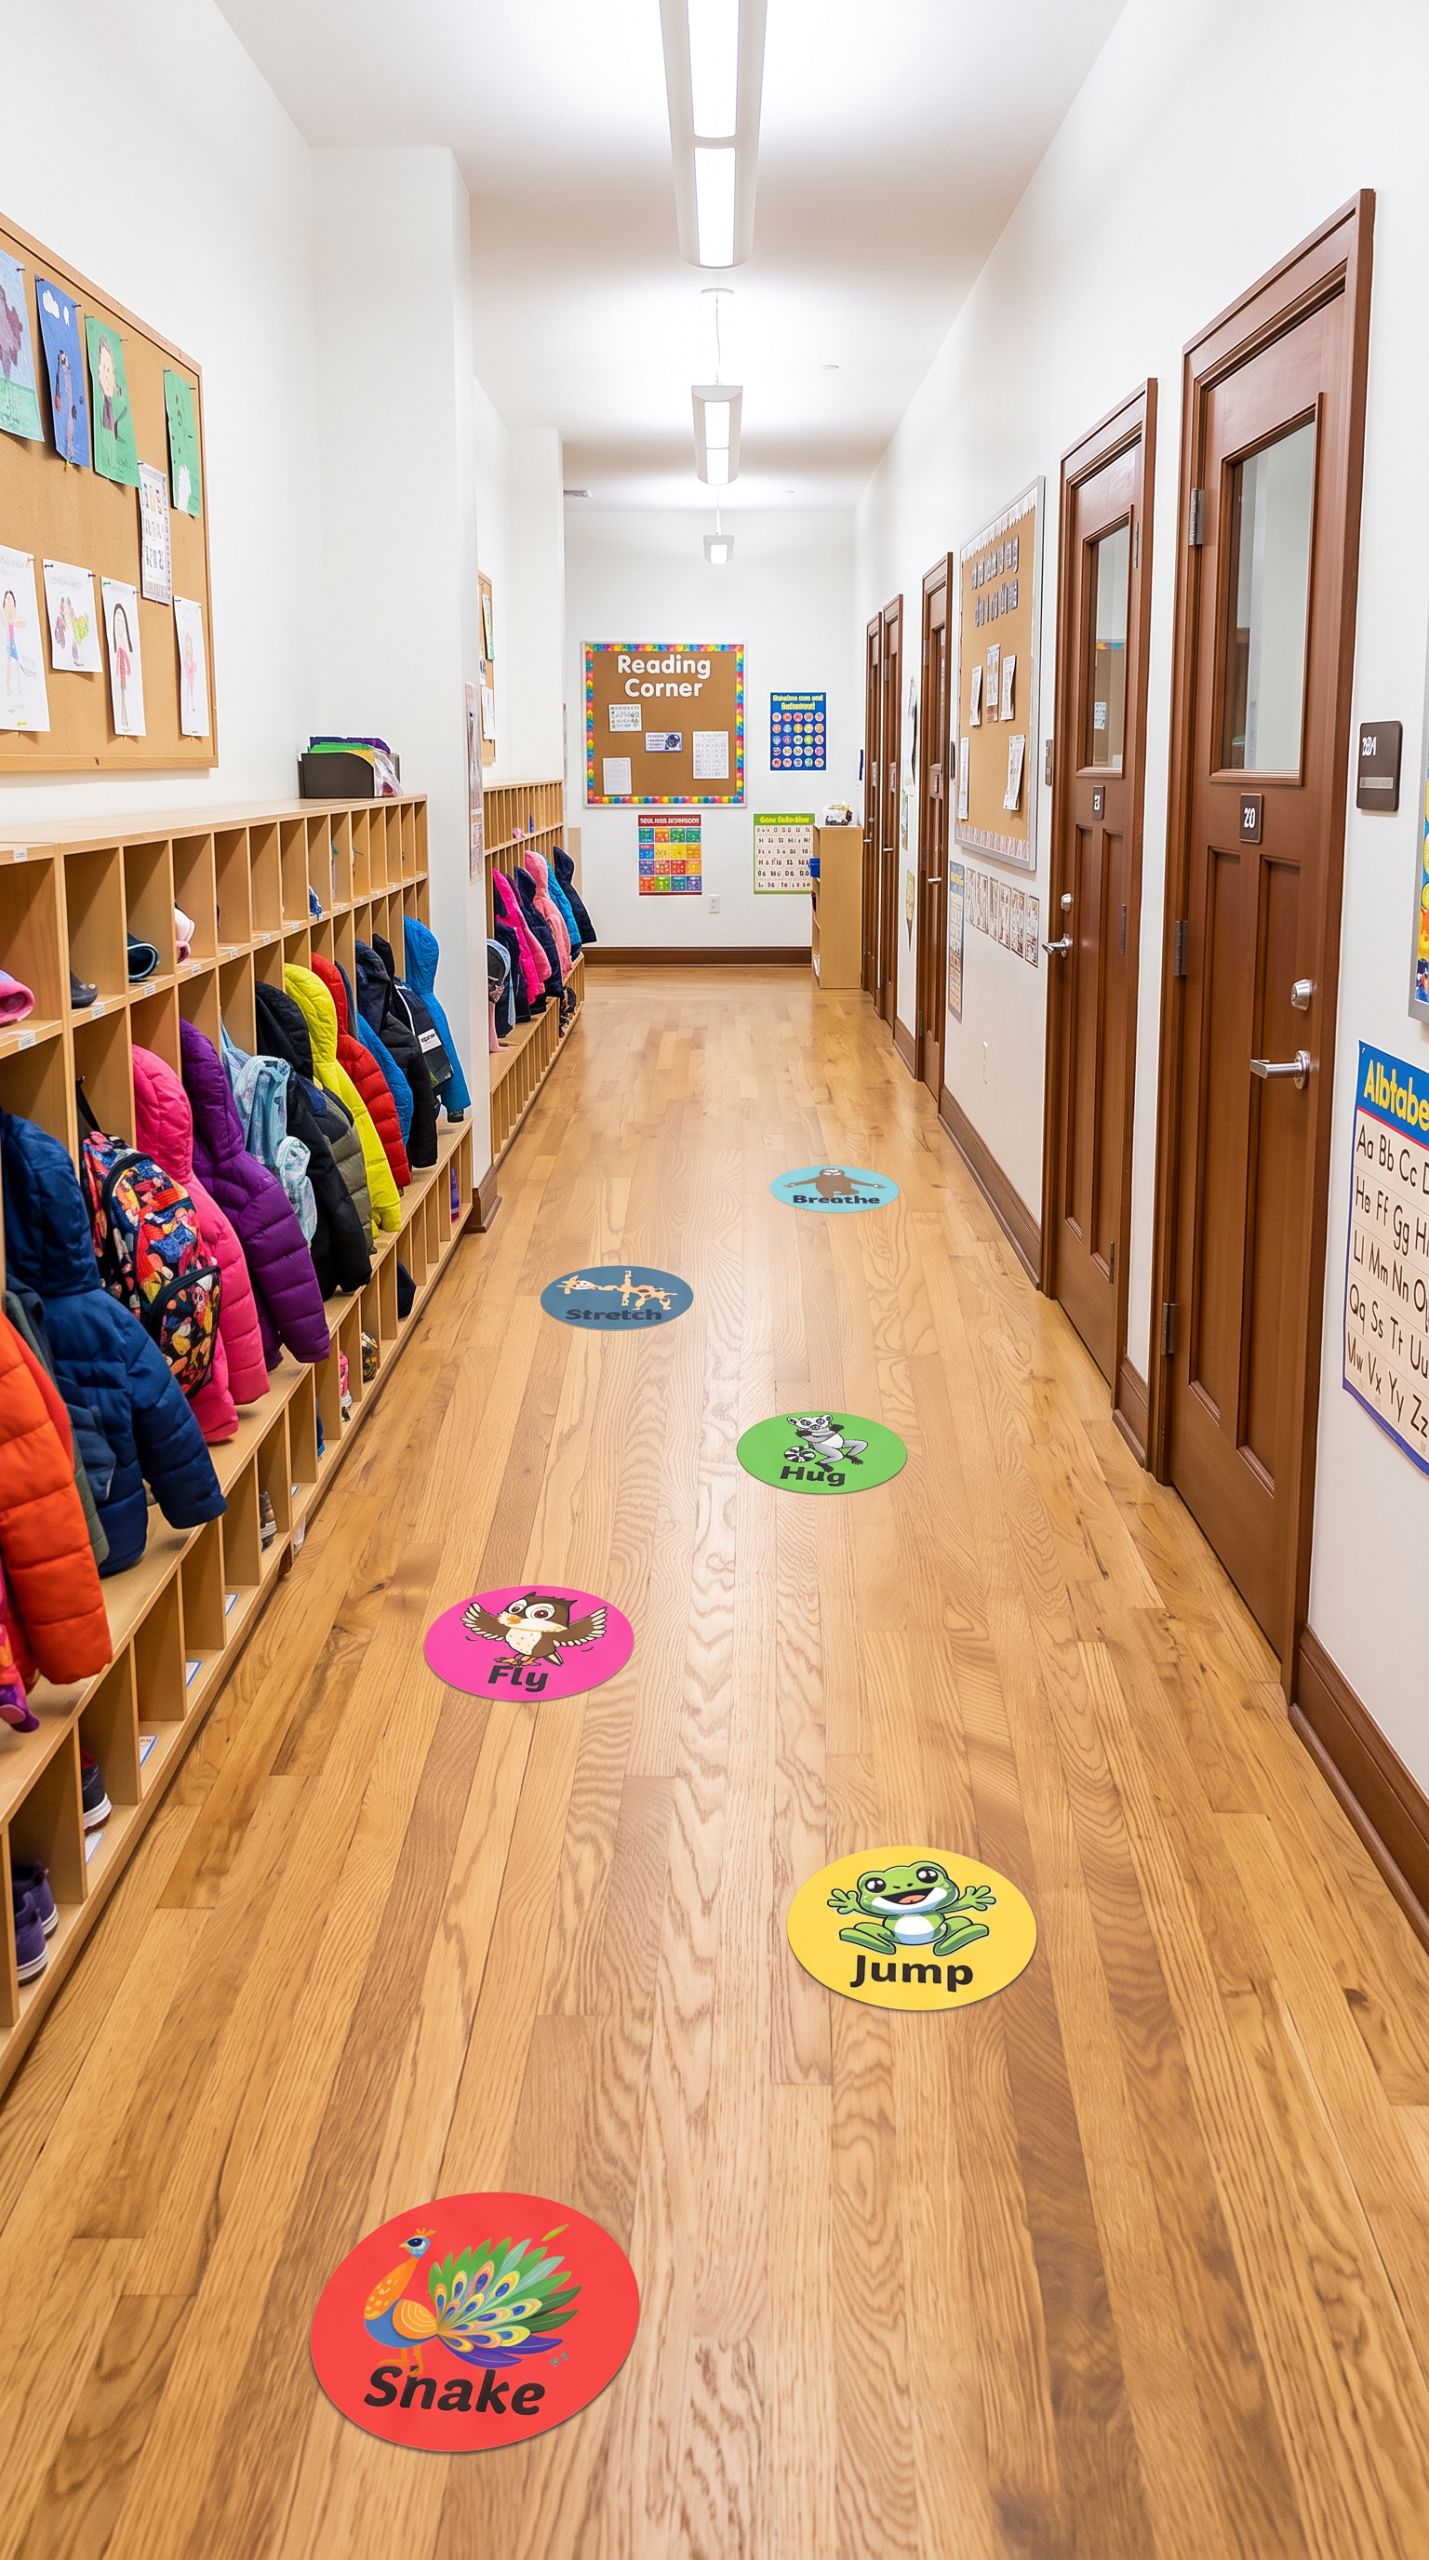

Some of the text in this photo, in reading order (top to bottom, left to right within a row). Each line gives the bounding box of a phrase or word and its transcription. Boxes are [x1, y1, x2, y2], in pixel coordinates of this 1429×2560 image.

[617, 653, 711, 680] Reading
[624, 678, 703, 697] Corner
[1356, 1123, 1374, 1160] Aa
[1378, 1133, 1395, 1172] Bb
[1399, 1148, 1418, 1188] Cc
[792, 1195, 881, 1205] Breathe
[1376, 1189, 1389, 1227] Ff
[1392, 1204, 1410, 1257] Gg
[1368, 1241, 1389, 1287] Mm
[1391, 1259, 1409, 1303] Nn
[565, 1308, 663, 1321] Stretch
[1349, 1283, 1428, 1380] Qq Ss Tt Uu
[1388, 1370, 1405, 1423] Yy
[1410, 1393, 1429, 1439] Zz
[780, 1465, 846, 1487] Hug
[487, 1665, 549, 1693] Fly
[850, 1954, 974, 1993] Jump
